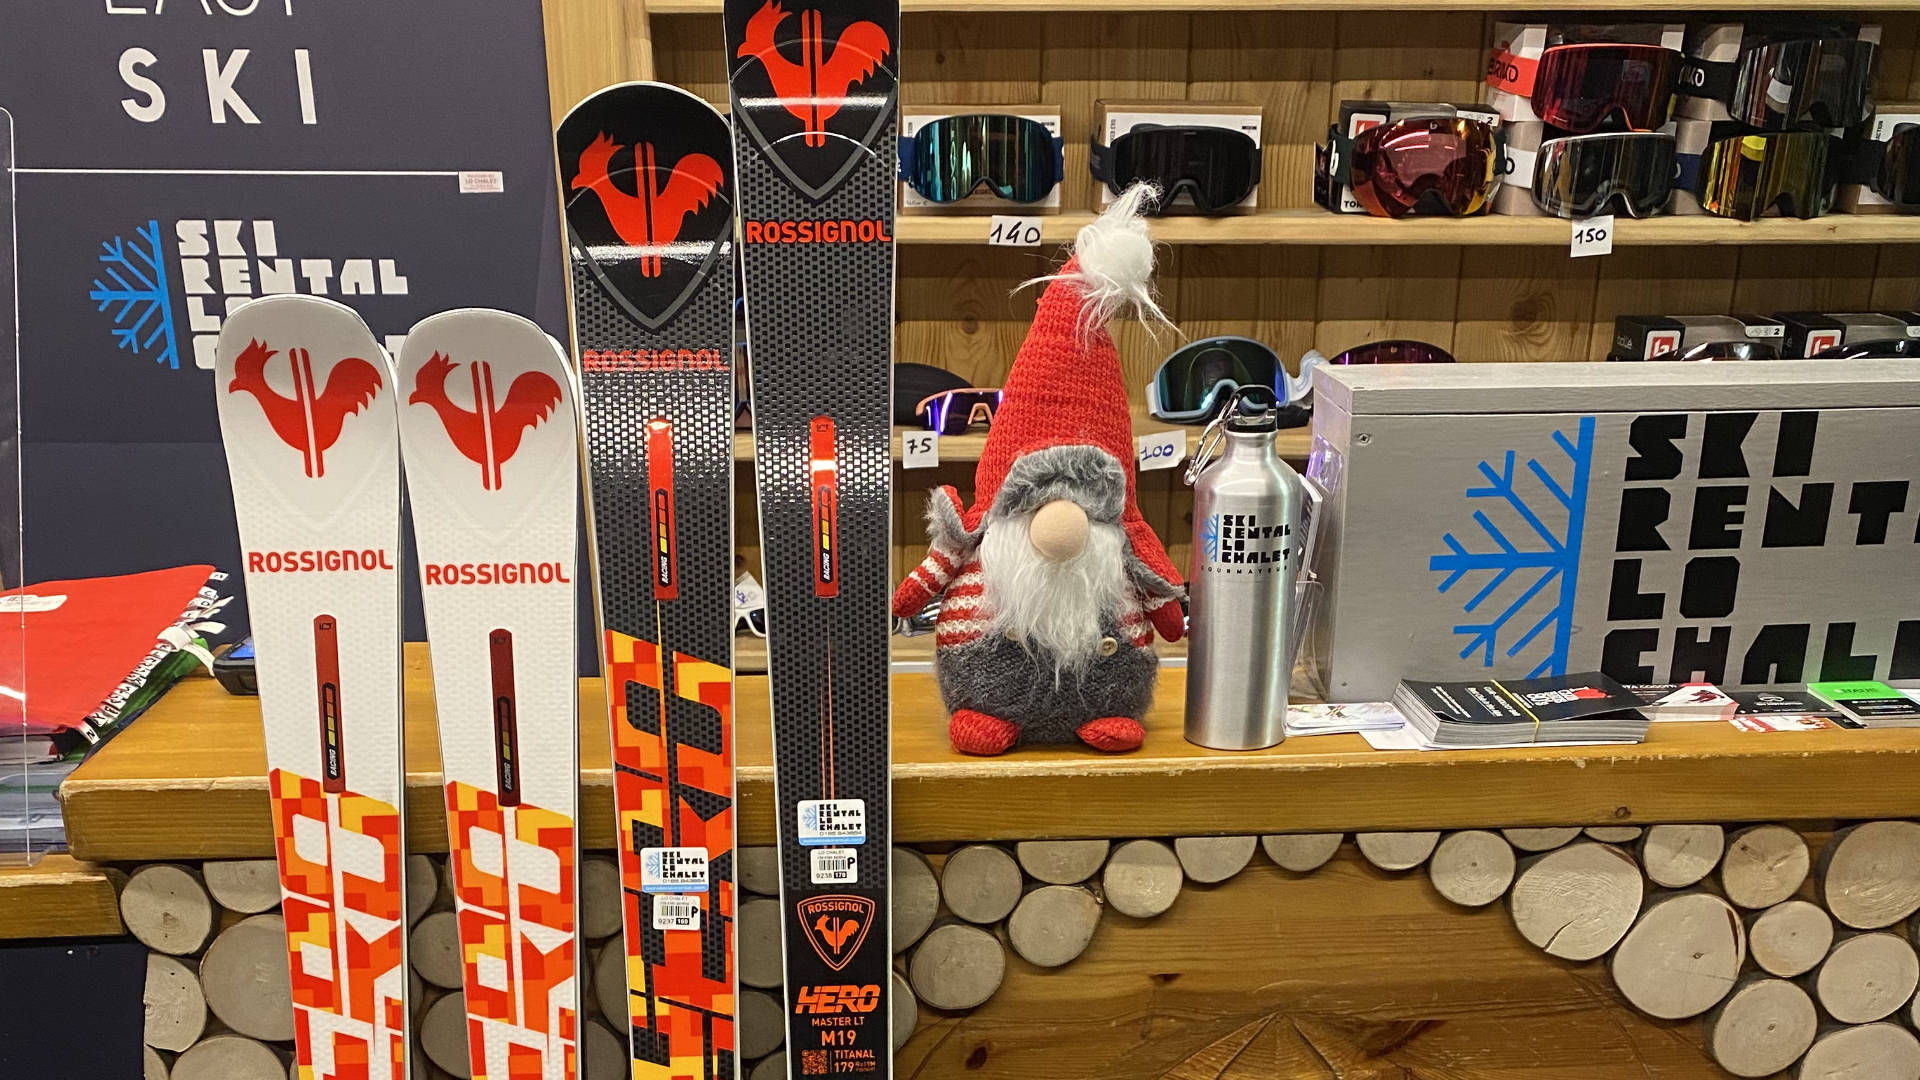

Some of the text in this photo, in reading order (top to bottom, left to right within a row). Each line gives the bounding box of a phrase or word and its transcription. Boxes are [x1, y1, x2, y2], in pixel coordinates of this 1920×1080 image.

[118, 47, 317, 125] SKI
[175, 219, 278, 256] SKI
[746, 220, 892, 243] ROSSIGNOL
[991, 221, 1041, 244] 140
[1575, 228, 1607, 244] 150
[181, 258, 409, 295] RENTAL
[583, 348, 730, 373] ROSSIGNOL
[906, 437, 932, 455] 75
[1140, 443, 1175, 461] 100
[1624, 411, 1819, 481] SKI
[1223, 514, 1257, 527] SKI
[1615, 480, 1920, 552] RENT
[1222, 524, 1291, 540] RENTAL
[1221, 547, 1290, 564] CHALET
[1222, 539, 1245, 552] LO
[248, 549, 394, 573] ROSSIGNOL
[660, 555, 669, 584] RACING
[822, 552, 831, 581] RACING
[425, 562, 571, 586] ROSSIGNOL
[1607, 555, 1741, 622] LO
[329, 748, 338, 777] RACING
[503, 762, 513, 790] RACING
[819, 809, 862, 817] RENTAL
[847, 857, 856, 870] P
[691, 906, 699, 918] P
[807, 901, 864, 915] ROSSIGNOL
[795, 984, 881, 1014] HERO
[811, 1016, 865, 1027] MASTER LT
[821, 1030, 857, 1046] M19
[834, 1049, 876, 1059] TITANAL
[834, 1061, 854, 1073] 179
